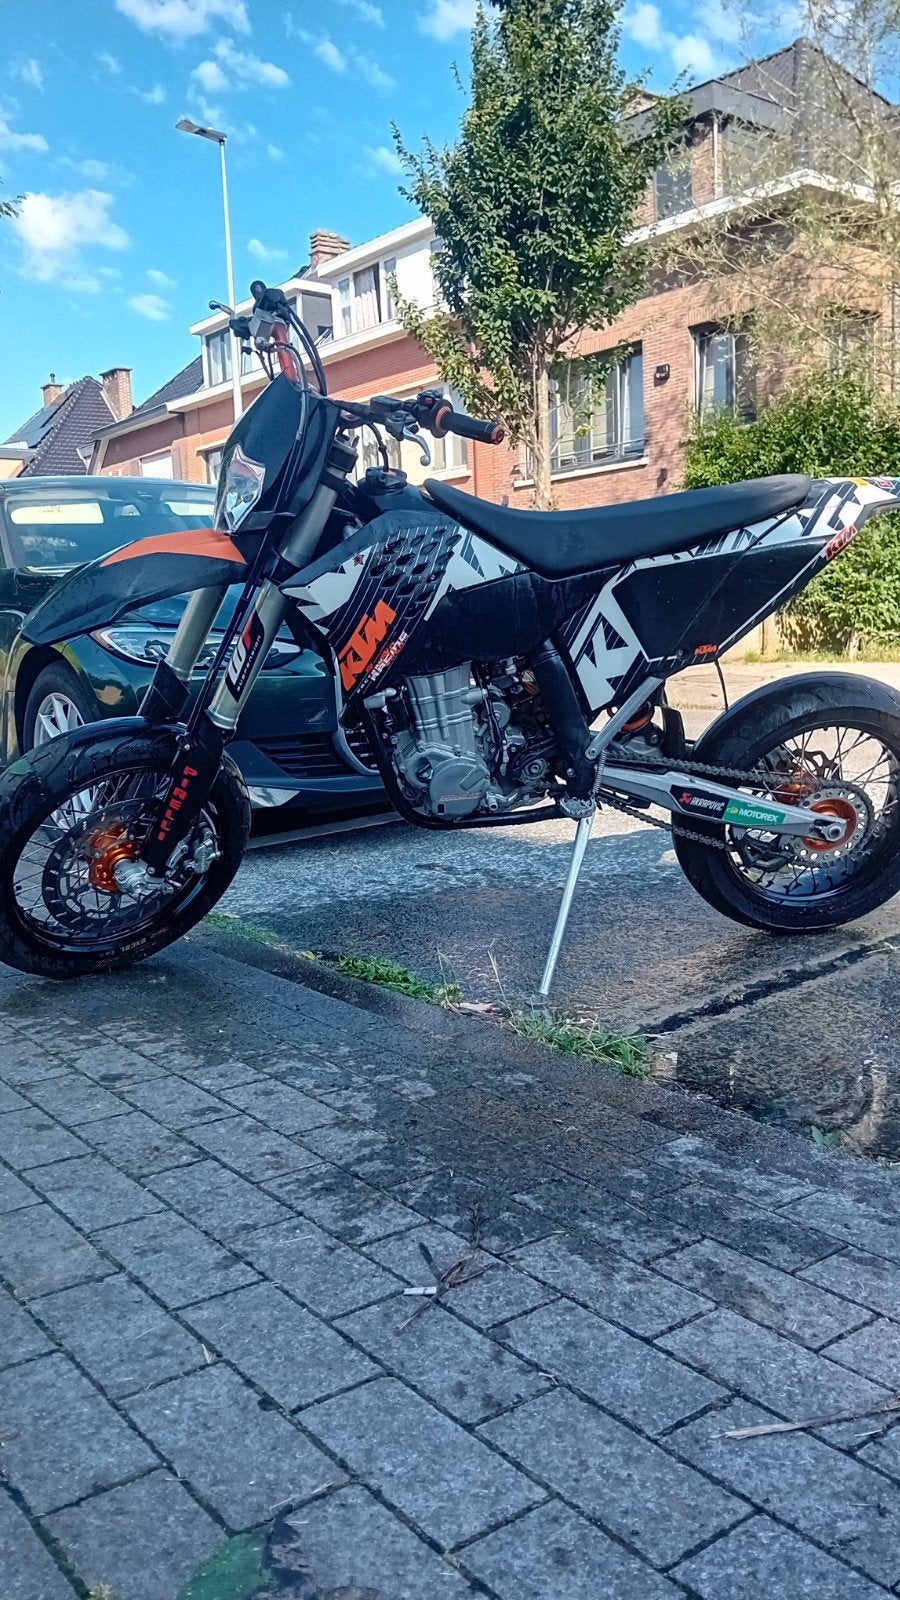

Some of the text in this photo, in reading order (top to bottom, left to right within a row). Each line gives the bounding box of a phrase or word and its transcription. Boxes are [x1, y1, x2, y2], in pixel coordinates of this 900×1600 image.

[338, 598, 397, 692] KTM
[694, 644, 718, 656] KTM
[157, 765, 198, 841] PIRELLI
[738, 808, 779, 823] MOTOREX
